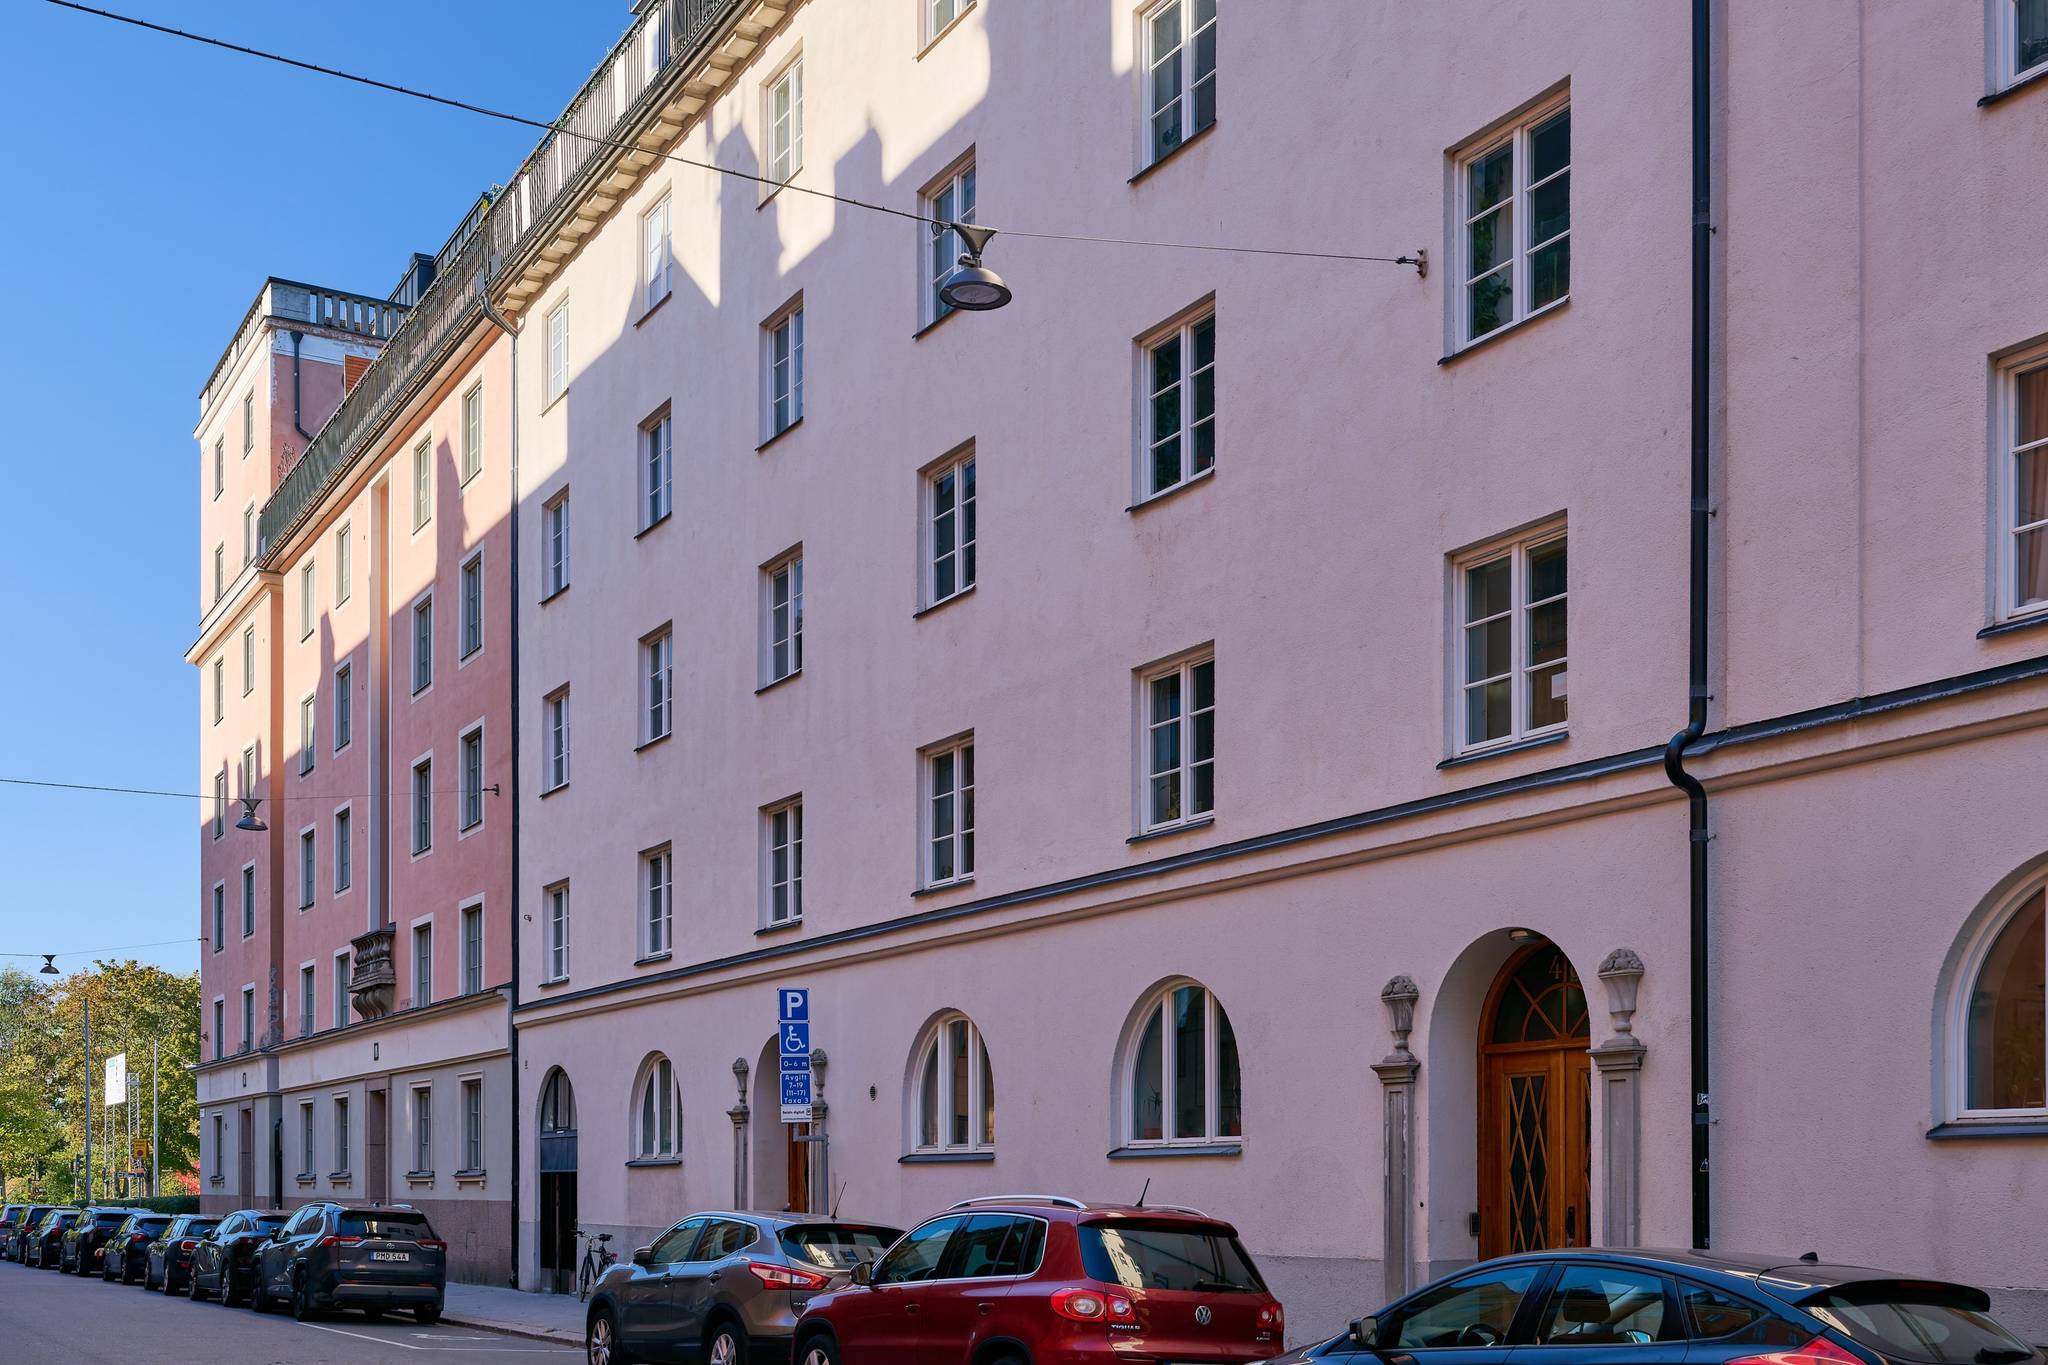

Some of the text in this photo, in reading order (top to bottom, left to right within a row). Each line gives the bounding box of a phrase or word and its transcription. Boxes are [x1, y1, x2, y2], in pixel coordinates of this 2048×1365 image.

[786, 991, 803, 1018] P
[784, 1074, 807, 1082] Avgift
[788, 1081, 804, 1089] 7-19
[786, 1089, 806, 1097] (11-17)
[375, 1252, 391, 1260] PMD
